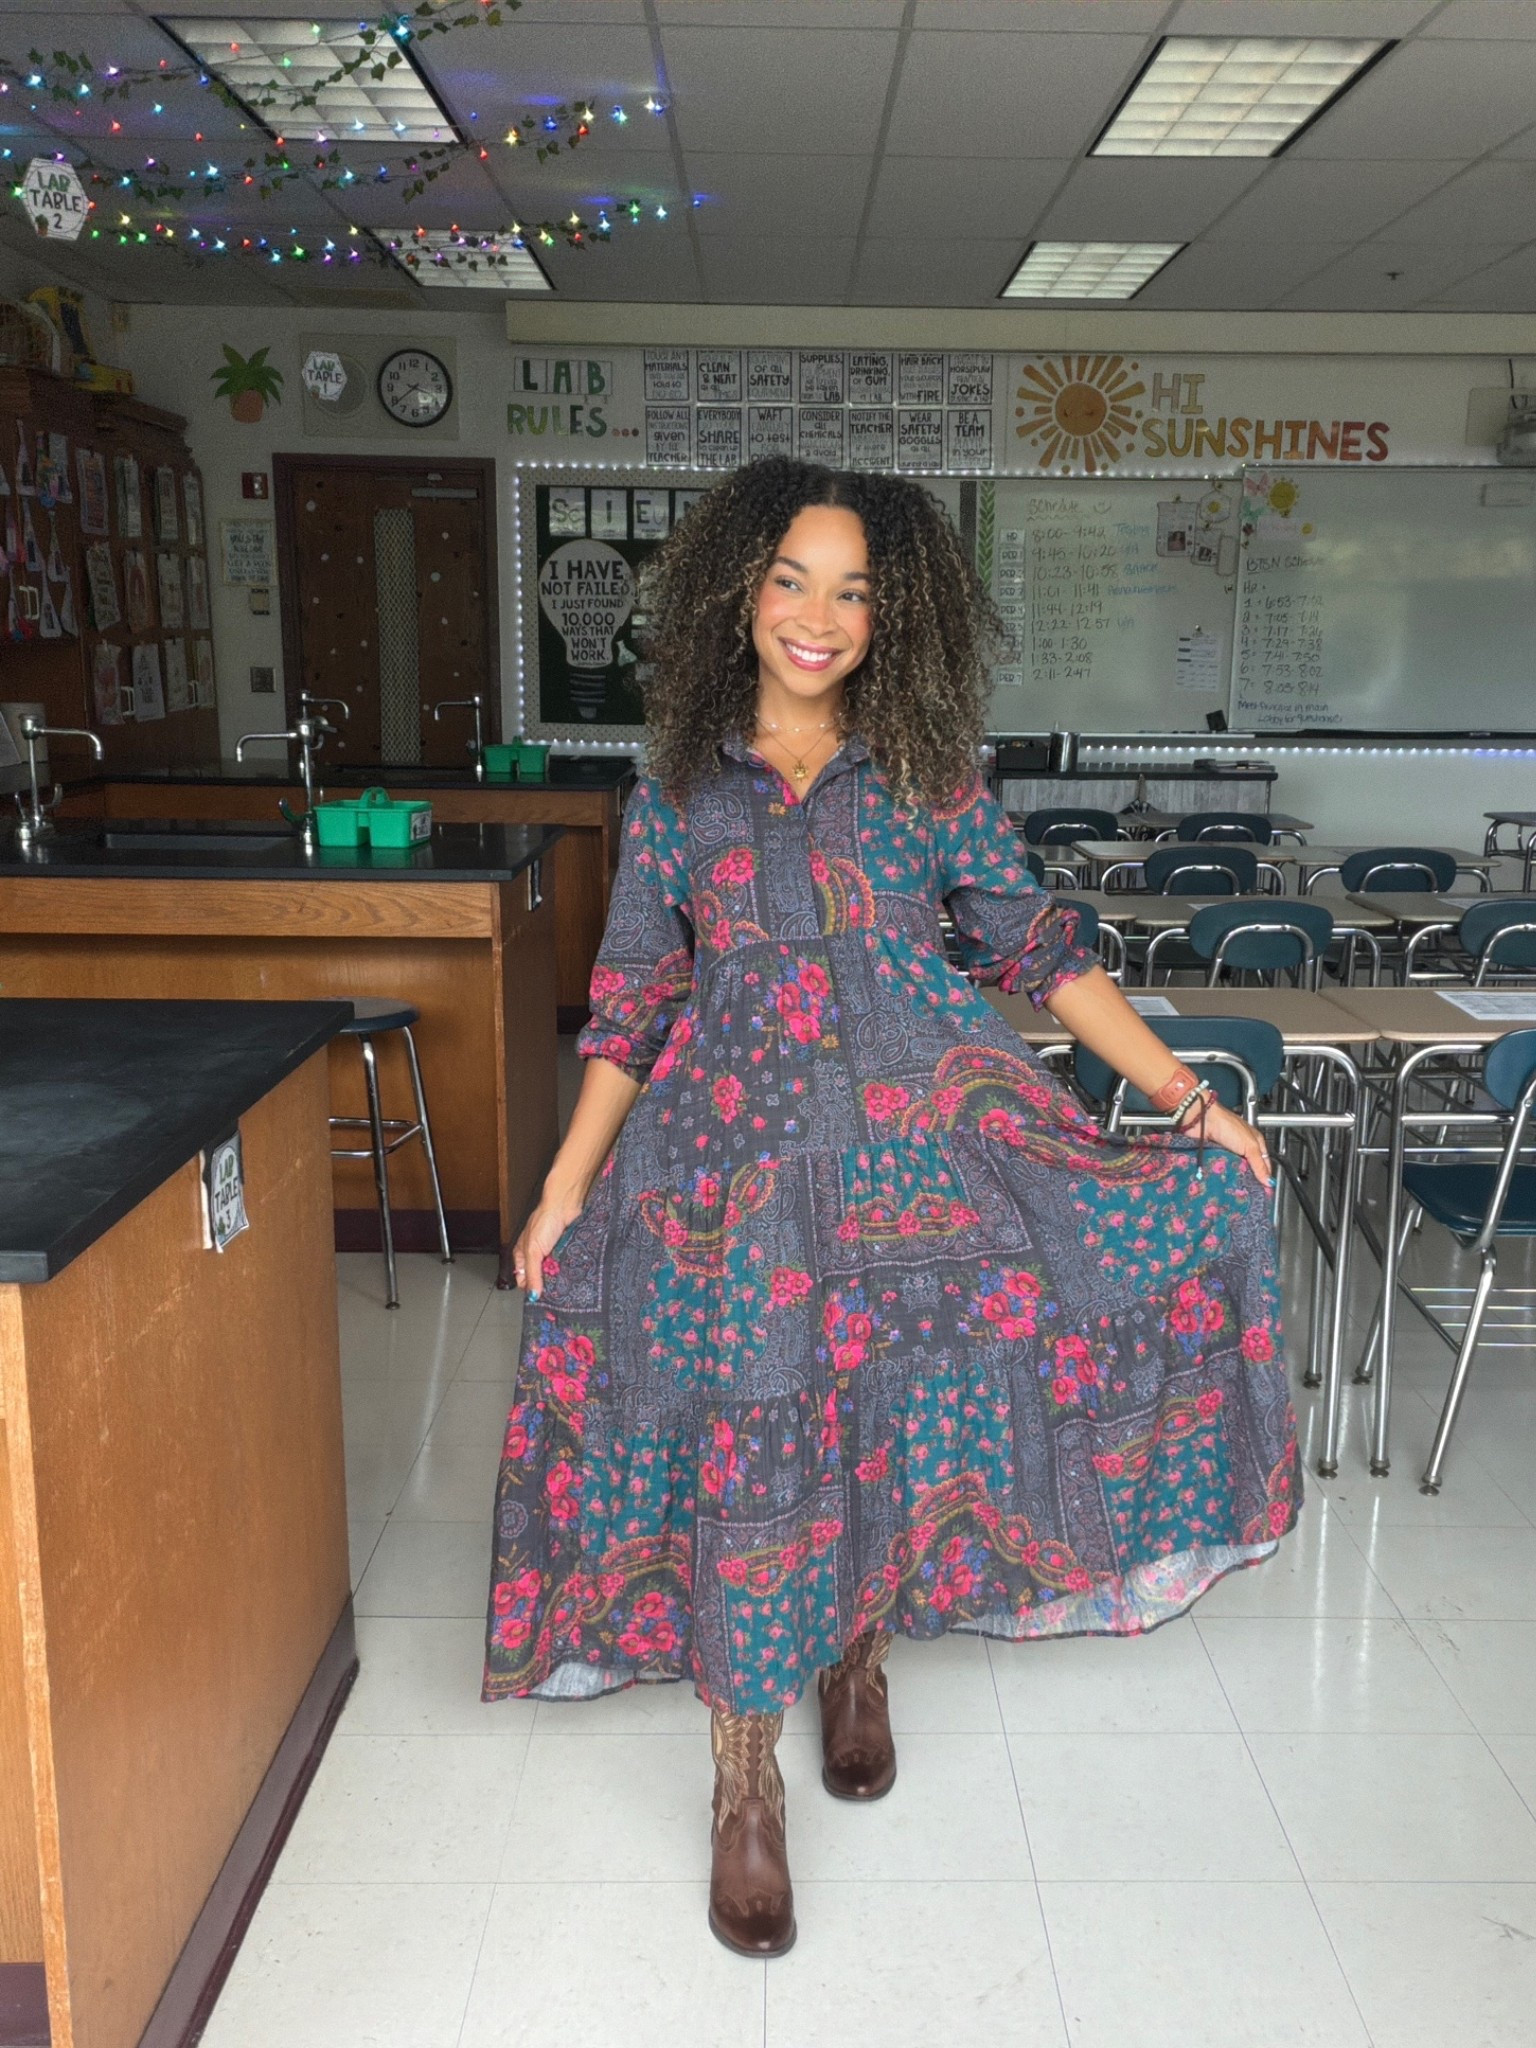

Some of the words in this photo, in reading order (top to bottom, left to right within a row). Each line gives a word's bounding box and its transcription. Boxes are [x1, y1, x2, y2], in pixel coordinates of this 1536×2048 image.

[38, 170, 70, 192] LAB
[30, 189, 80, 213] TABLE
[54, 214, 62, 229] 2
[398, 362, 406, 370] 11
[410, 360, 420, 368] 12
[645, 362, 688, 372] MATERIALS
[700, 363, 730, 372] CLEAN
[770, 365, 782, 373] all
[308, 370, 342, 384] TABLE
[390, 372, 400, 380] 10
[431, 372, 438, 382] 2
[522, 360, 606, 394] LAB
[714, 374, 738, 384] NEAT
[750, 374, 790, 386] SAFETY
[865, 376, 886, 386] GUM
[387, 383, 394, 392] 9
[951, 384, 990, 395] JOKES
[1152, 372, 1206, 414] HI
[824, 391, 840, 401] LAB
[917, 390, 940, 402] FIRE
[400, 405, 407, 413] 7
[412, 409, 418, 418] 6
[647, 410, 675, 421] FOLLOW
[676, 410, 690, 421] ALL
[698, 410, 740, 420] EVERYBODY
[758, 408, 784, 421] WAFT
[801, 411, 840, 422] CONSIDER
[852, 412, 876, 422] NOTIFY
[879, 412, 890, 421] THE
[910, 412, 932, 422] WEAR
[958, 412, 969, 422] BE
[970, 412, 978, 422] A
[850, 424, 892, 434] TEACHER
[901, 424, 940, 435] SAFETY
[955, 424, 984, 437] TEAM
[654, 430, 685, 442] given
[699, 430, 740, 444] SHARE
[751, 433, 764, 442] to
[768, 432, 790, 442] test
[800, 431, 842, 439] CHEMICALS
[900, 436, 942, 445] GOGGLES
[1142, 417, 1390, 462] SUNSHINES
[963, 448, 987, 458] your
[700, 454, 717, 466] THE
[1006, 533, 1018, 542] HR
[1002, 550, 1018, 560] PER
[549, 560, 558, 580] I
[568, 560, 624, 580] HAVE
[1000, 570, 1016, 578] PER
[541, 581, 570, 596] NOT
[1000, 587, 1016, 596] PER
[552, 600, 557, 610] I
[560, 600, 586, 610] JUST
[587, 598, 624, 609] FOUND
[1000, 605, 1016, 614] PER
[562, 612, 615, 628] 10,000
[562, 626, 588, 637] WAYS
[588, 626, 614, 636] THAT
[572, 637, 607, 649] WON'T
[1000, 674, 1014, 683] PER
[220, 1154, 234, 1184] LAB
[215, 1176, 239, 1213] TABLE
[226, 1209, 232, 1230] 3
